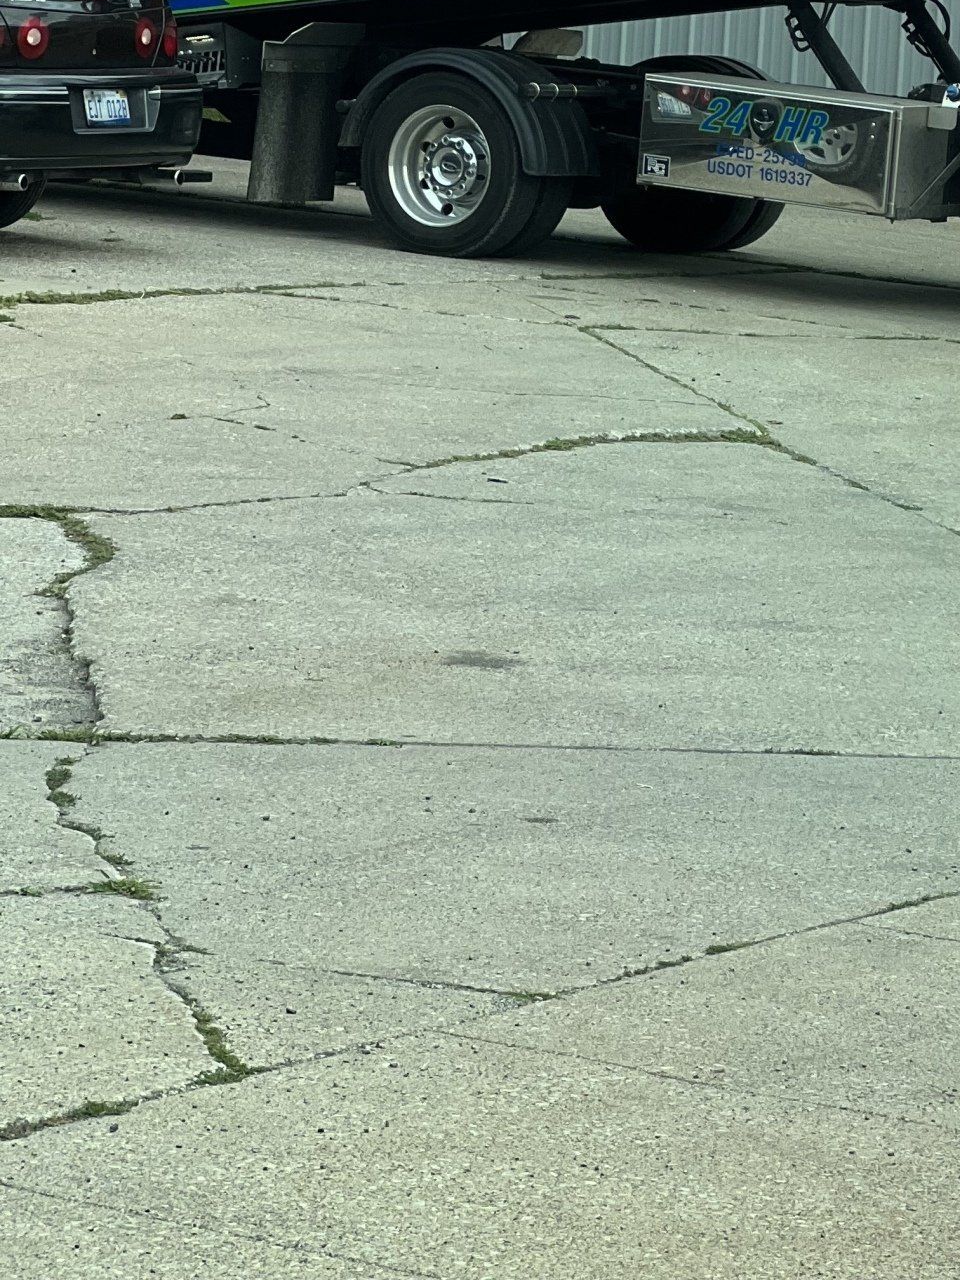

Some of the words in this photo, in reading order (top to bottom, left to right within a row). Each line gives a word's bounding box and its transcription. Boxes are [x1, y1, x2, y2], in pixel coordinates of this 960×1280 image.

[699, 97, 752, 136] 24
[772, 106, 830, 145] HR
[707, 159, 754, 179] USDOT
[759, 167, 813, 187] 1619337
